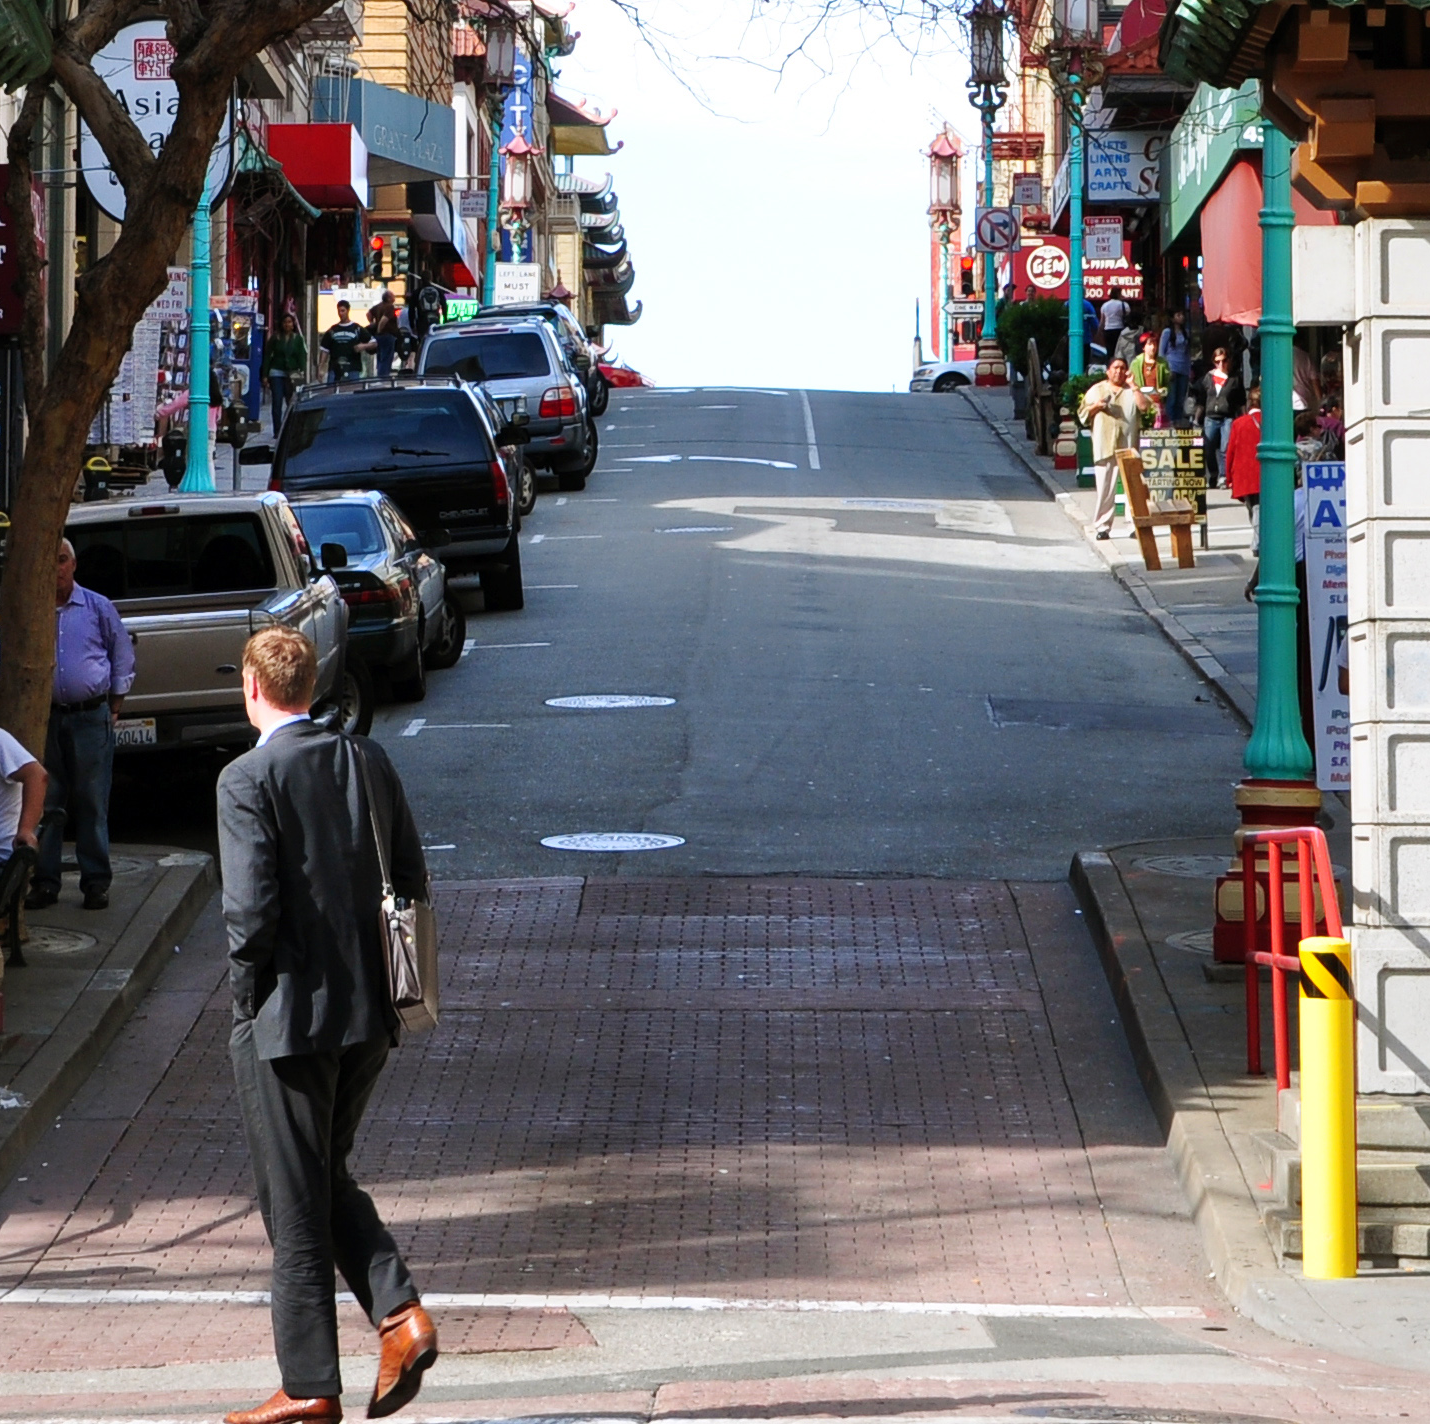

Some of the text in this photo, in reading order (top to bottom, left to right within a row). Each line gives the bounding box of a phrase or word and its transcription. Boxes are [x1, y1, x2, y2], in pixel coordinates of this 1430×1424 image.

[373, 125, 407, 153] GRANT
[1093, 140, 1127, 150] GIFTS
[1090, 155, 1131, 164] LINENS
[1094, 168, 1127, 177] ARTS
[1090, 181, 1132, 191] CRAFTS
[1096, 245, 1111, 253] TIME
[1032, 257, 1066, 274] GEM
[504, 282, 529, 290] MUST
[1083, 276, 1103, 286] FINE
[1172, 429, 1202, 437] GALLERY
[1141, 448, 1204, 469] SALE
[1183, 478, 1202, 486] NOW
[439, 508, 489, 519] CHEVROLET
